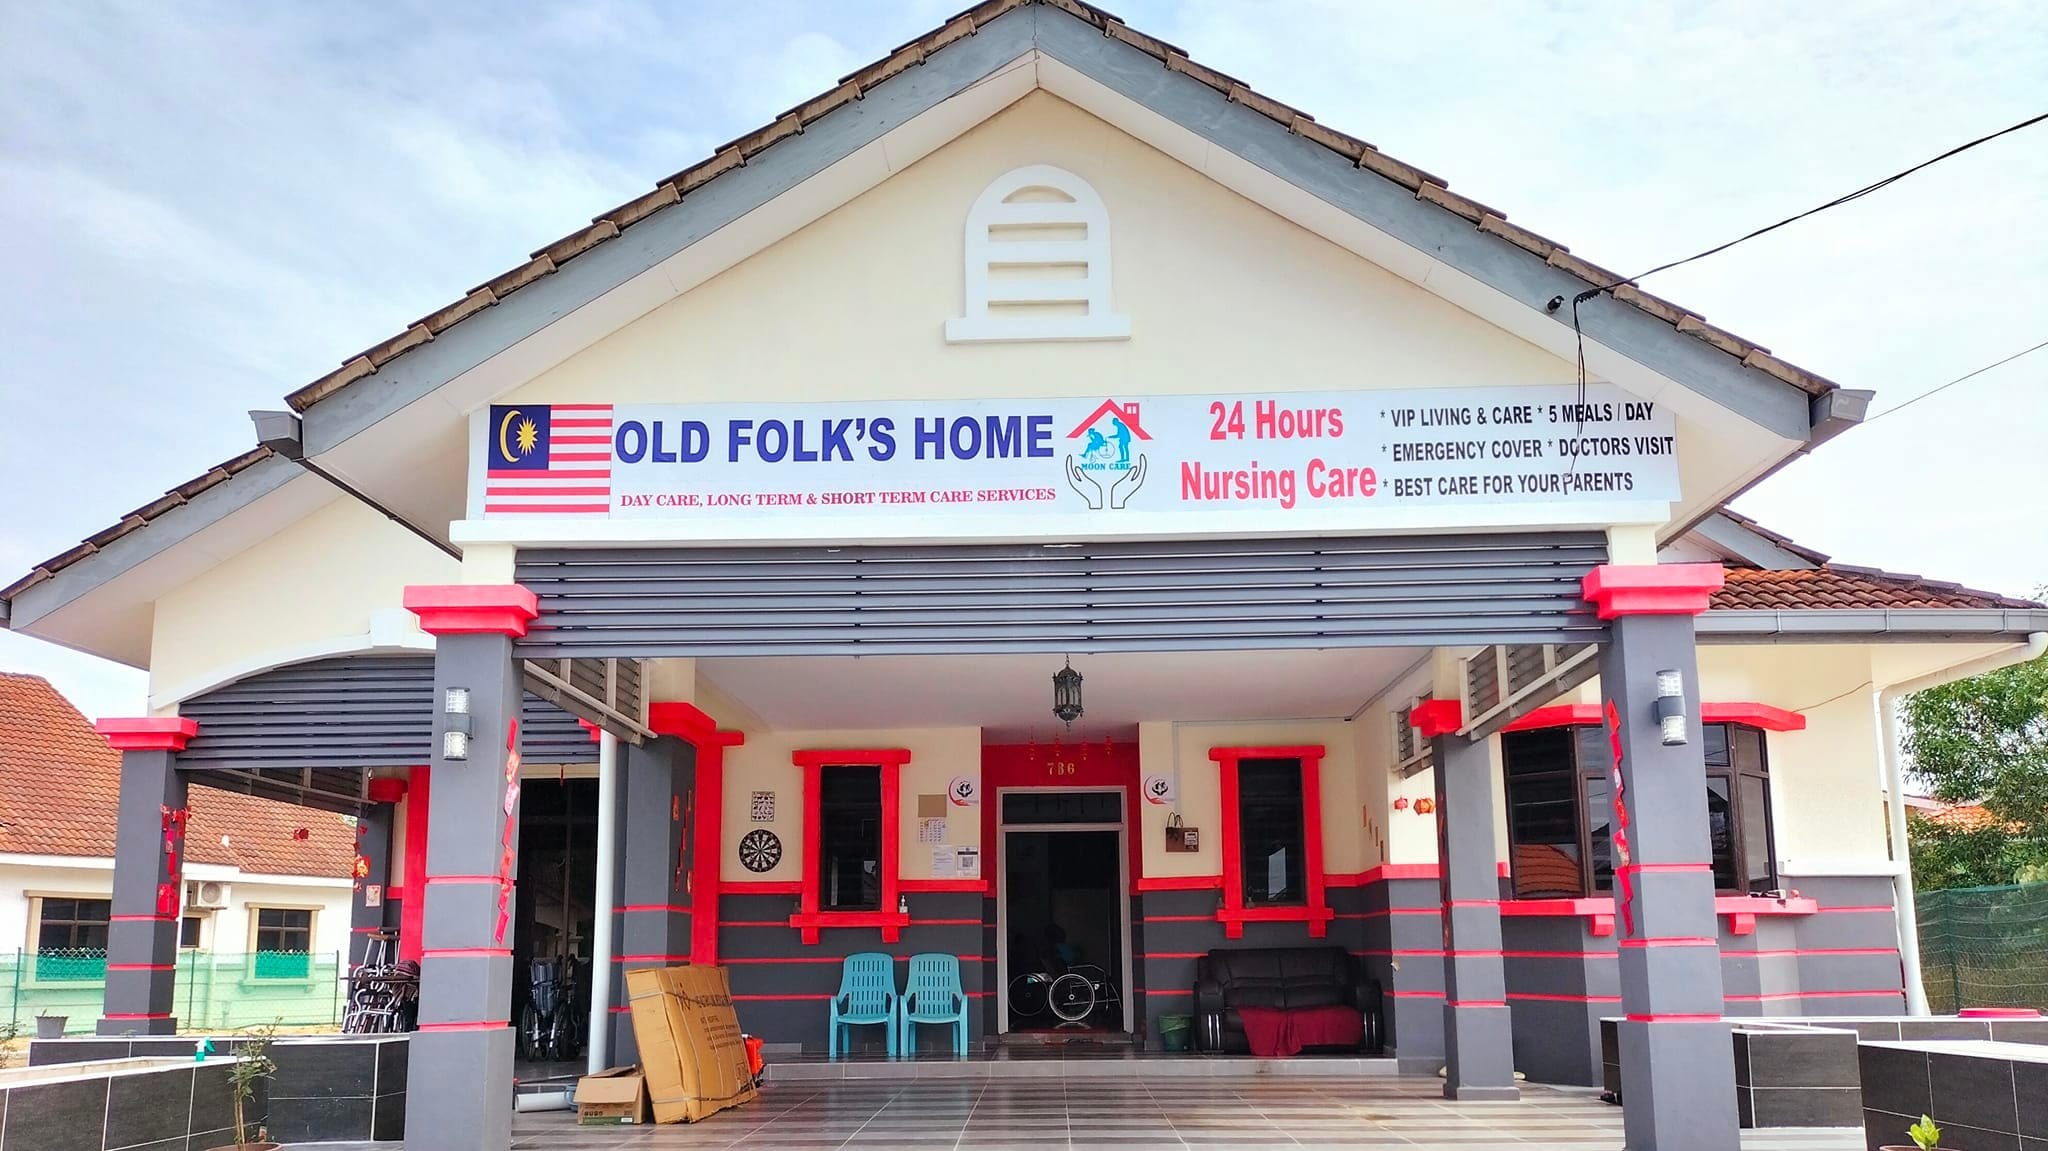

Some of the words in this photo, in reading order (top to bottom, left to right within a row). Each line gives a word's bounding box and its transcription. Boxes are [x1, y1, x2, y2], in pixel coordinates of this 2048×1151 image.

[1209, 400, 1246, 441] 24
[1255, 399, 1344, 440] Hours
[1391, 409, 1416, 427] VIP
[1421, 407, 1472, 426] LIVING
[1477, 406, 1488, 425] &
[1492, 405, 1533, 424] CARE
[1549, 404, 1558, 423] 5
[1562, 403, 1613, 423] MEALS
[1625, 402, 1654, 421] DAY
[615, 420, 710, 464] OLD
[728, 417, 897, 464] FOLK'S
[914, 414, 1055, 461] HOME
[1393, 440, 1486, 462] EMERGENCY
[1492, 439, 1543, 458] COVER
[1559, 437, 1630, 457] DOCTORS
[1635, 436, 1674, 455] VISIT
[1181, 460, 1296, 510] Nursing
[1306, 458, 1377, 498] Care
[1394, 477, 1433, 497] BEST
[1438, 476, 1478, 495] CARE
[1483, 475, 1514, 494] FOR
[1517, 474, 1560, 493] YOUR
[1562, 472, 1633, 495] PARENTS
[620, 494, 654, 508] DAY
[656, 494, 703, 509] CARE,
[706, 494, 752, 507] LONG
[755, 493, 803, 506] TERM
[806, 493, 818, 505] &
[821, 492, 876, 505] SHORT
[879, 491, 926, 504] TERM
[929, 490, 973, 503] CARE
[976, 488, 1056, 502] SERVICES
